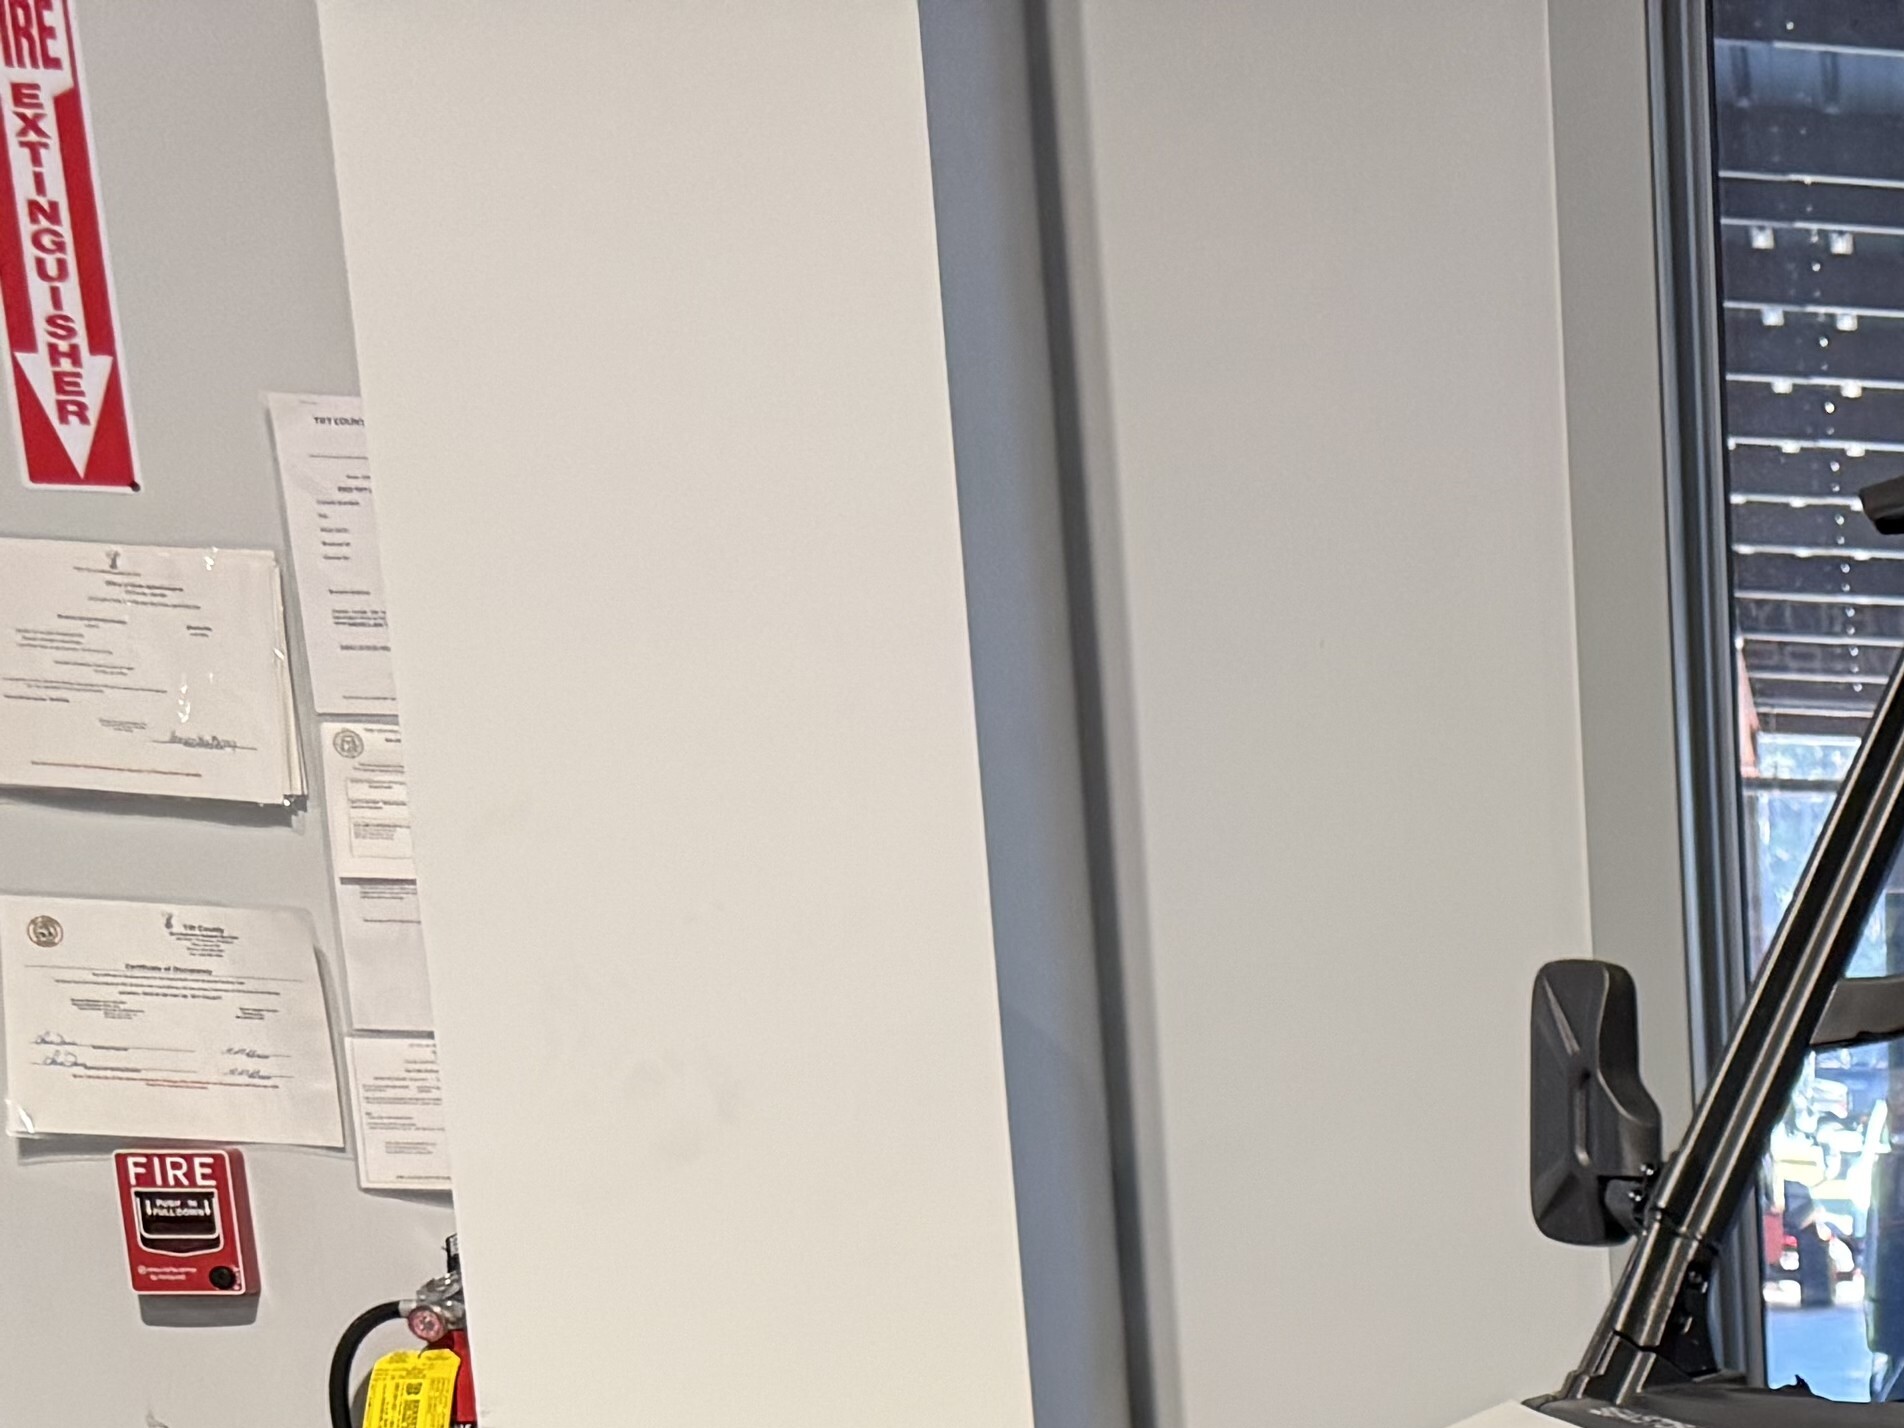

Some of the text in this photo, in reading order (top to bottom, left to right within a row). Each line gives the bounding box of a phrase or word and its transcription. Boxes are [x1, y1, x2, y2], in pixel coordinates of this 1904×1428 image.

[0, 0, 63, 70] IRE
[10, 82, 91, 426] EXTINGUISHER
[127, 1156, 217, 1186] FIRE
